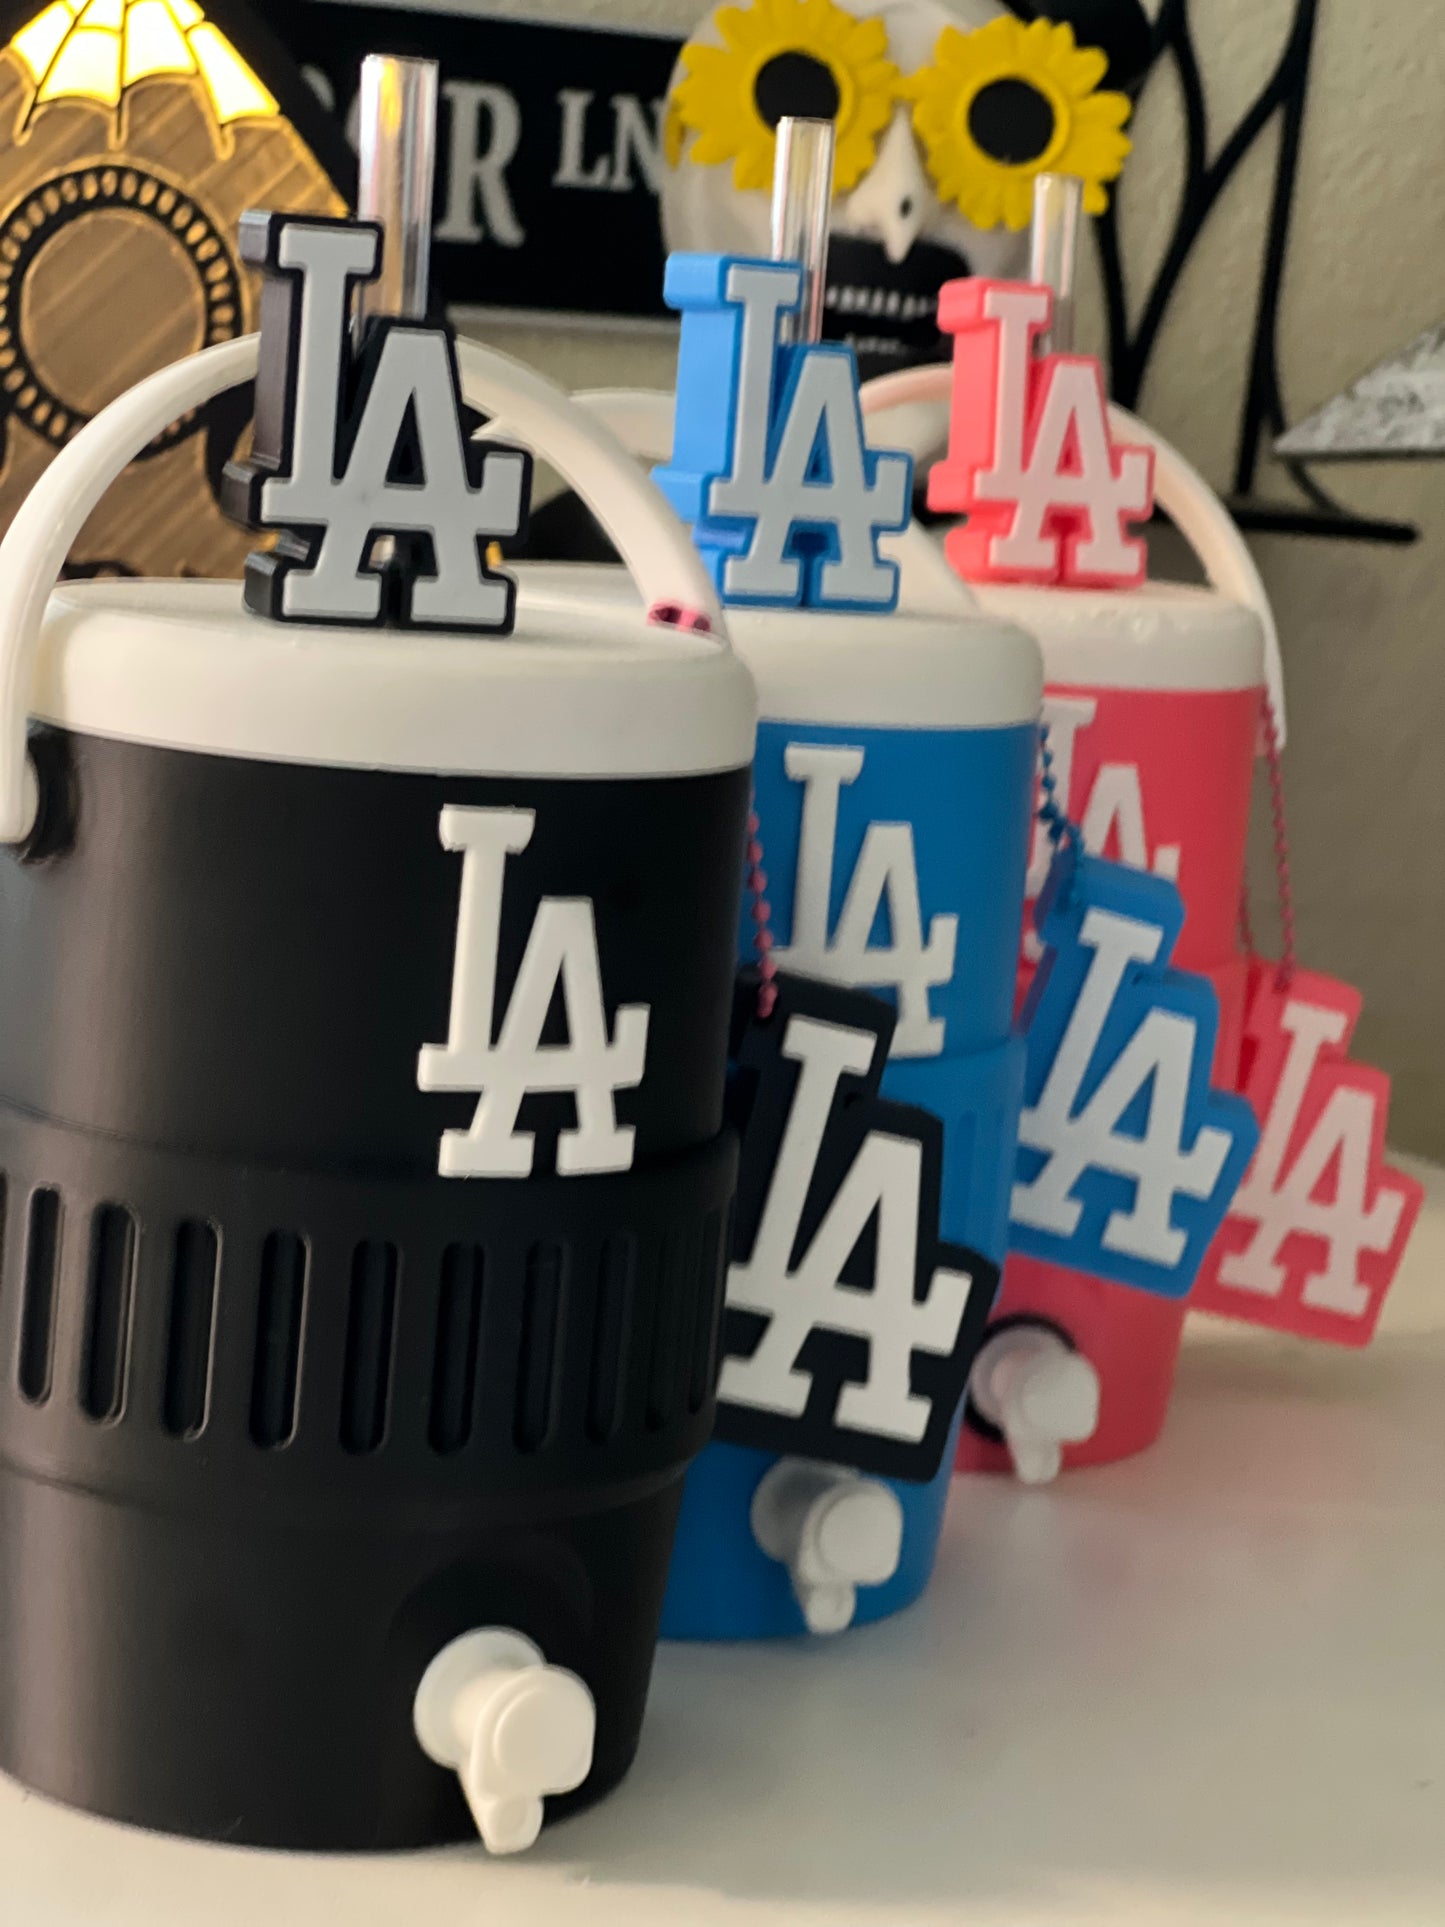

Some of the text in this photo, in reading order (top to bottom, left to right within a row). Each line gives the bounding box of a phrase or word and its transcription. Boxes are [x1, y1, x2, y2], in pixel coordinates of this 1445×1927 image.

[261, 222, 525, 626] LA
[708, 263, 909, 604] LA
[973, 290, 1155, 577] LA
[417, 803, 652, 1178] LA
[769, 741, 959, 1058] LA
[715, 1013, 974, 1445] LA
[1009, 906, 1234, 1269] LA
[1217, 1000, 1406, 1320] LA
